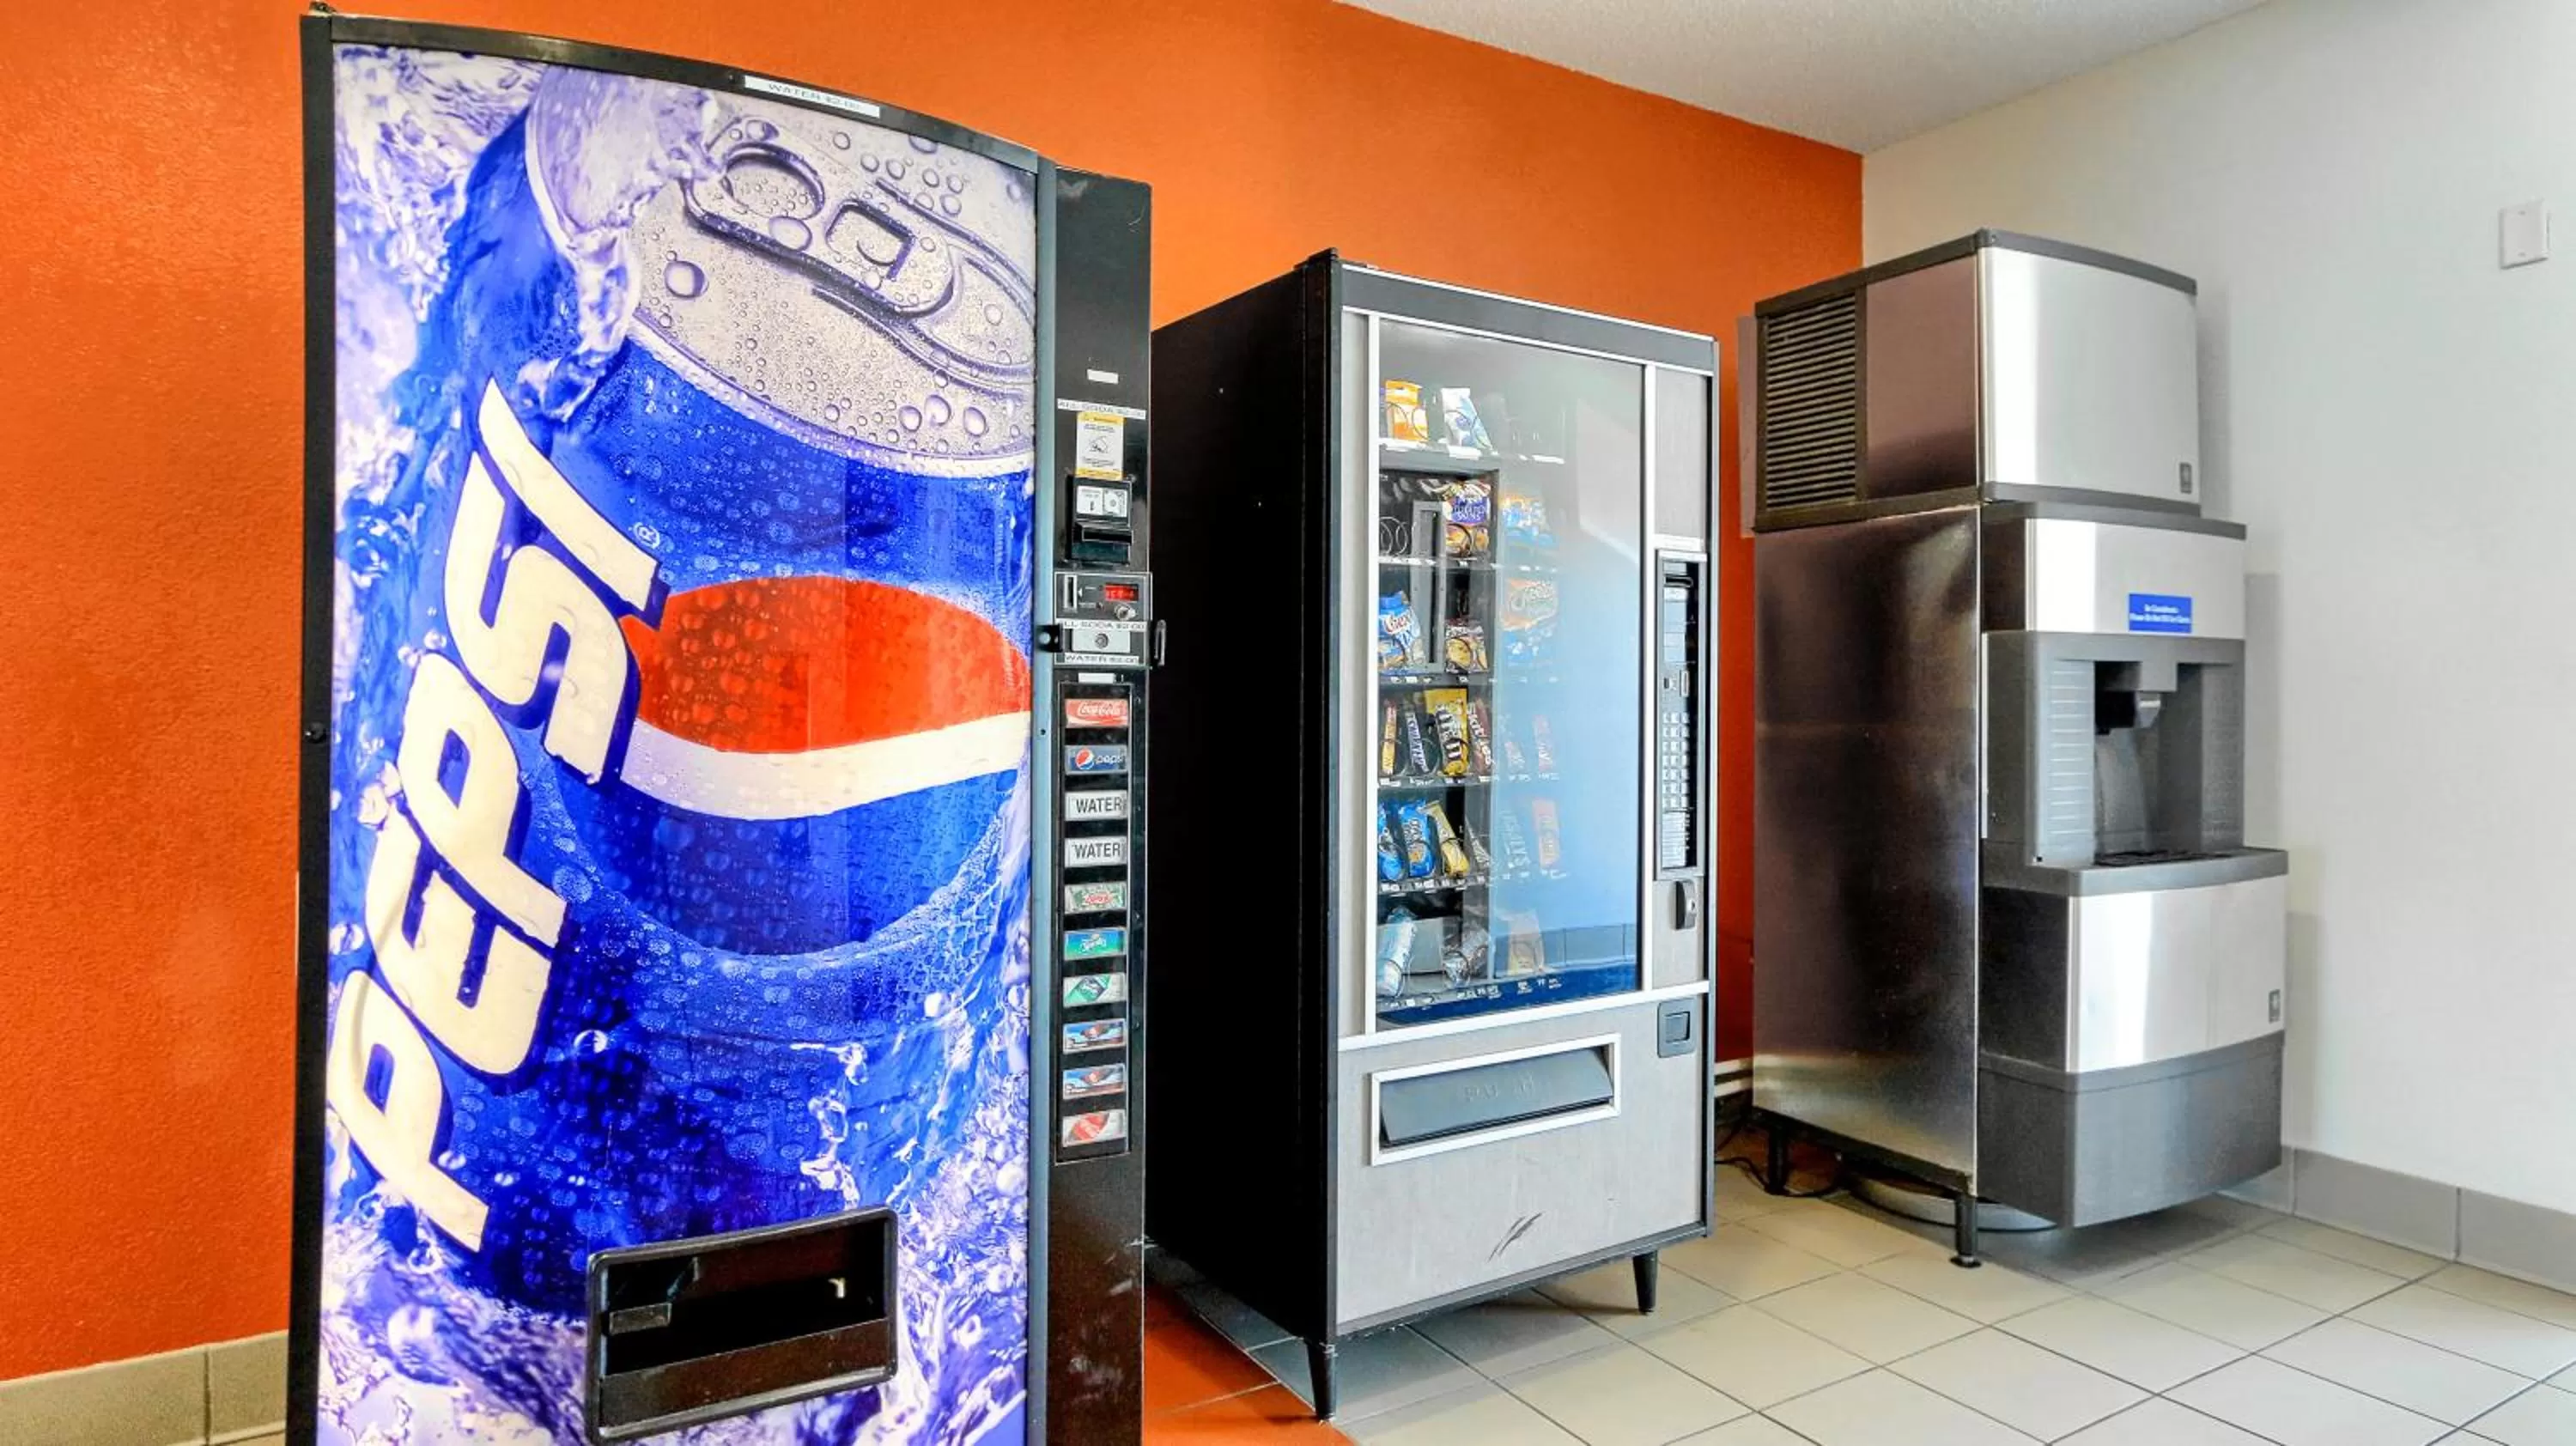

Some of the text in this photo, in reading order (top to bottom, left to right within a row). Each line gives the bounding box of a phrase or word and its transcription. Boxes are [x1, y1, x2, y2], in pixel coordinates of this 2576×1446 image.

[769, 82, 821, 100] WATER
[1066, 654, 1107, 664] WATER
[1076, 796, 1123, 813] WATER
[326, 376, 661, 1253] PEPSI
[1072, 841, 1121, 860] WATER
